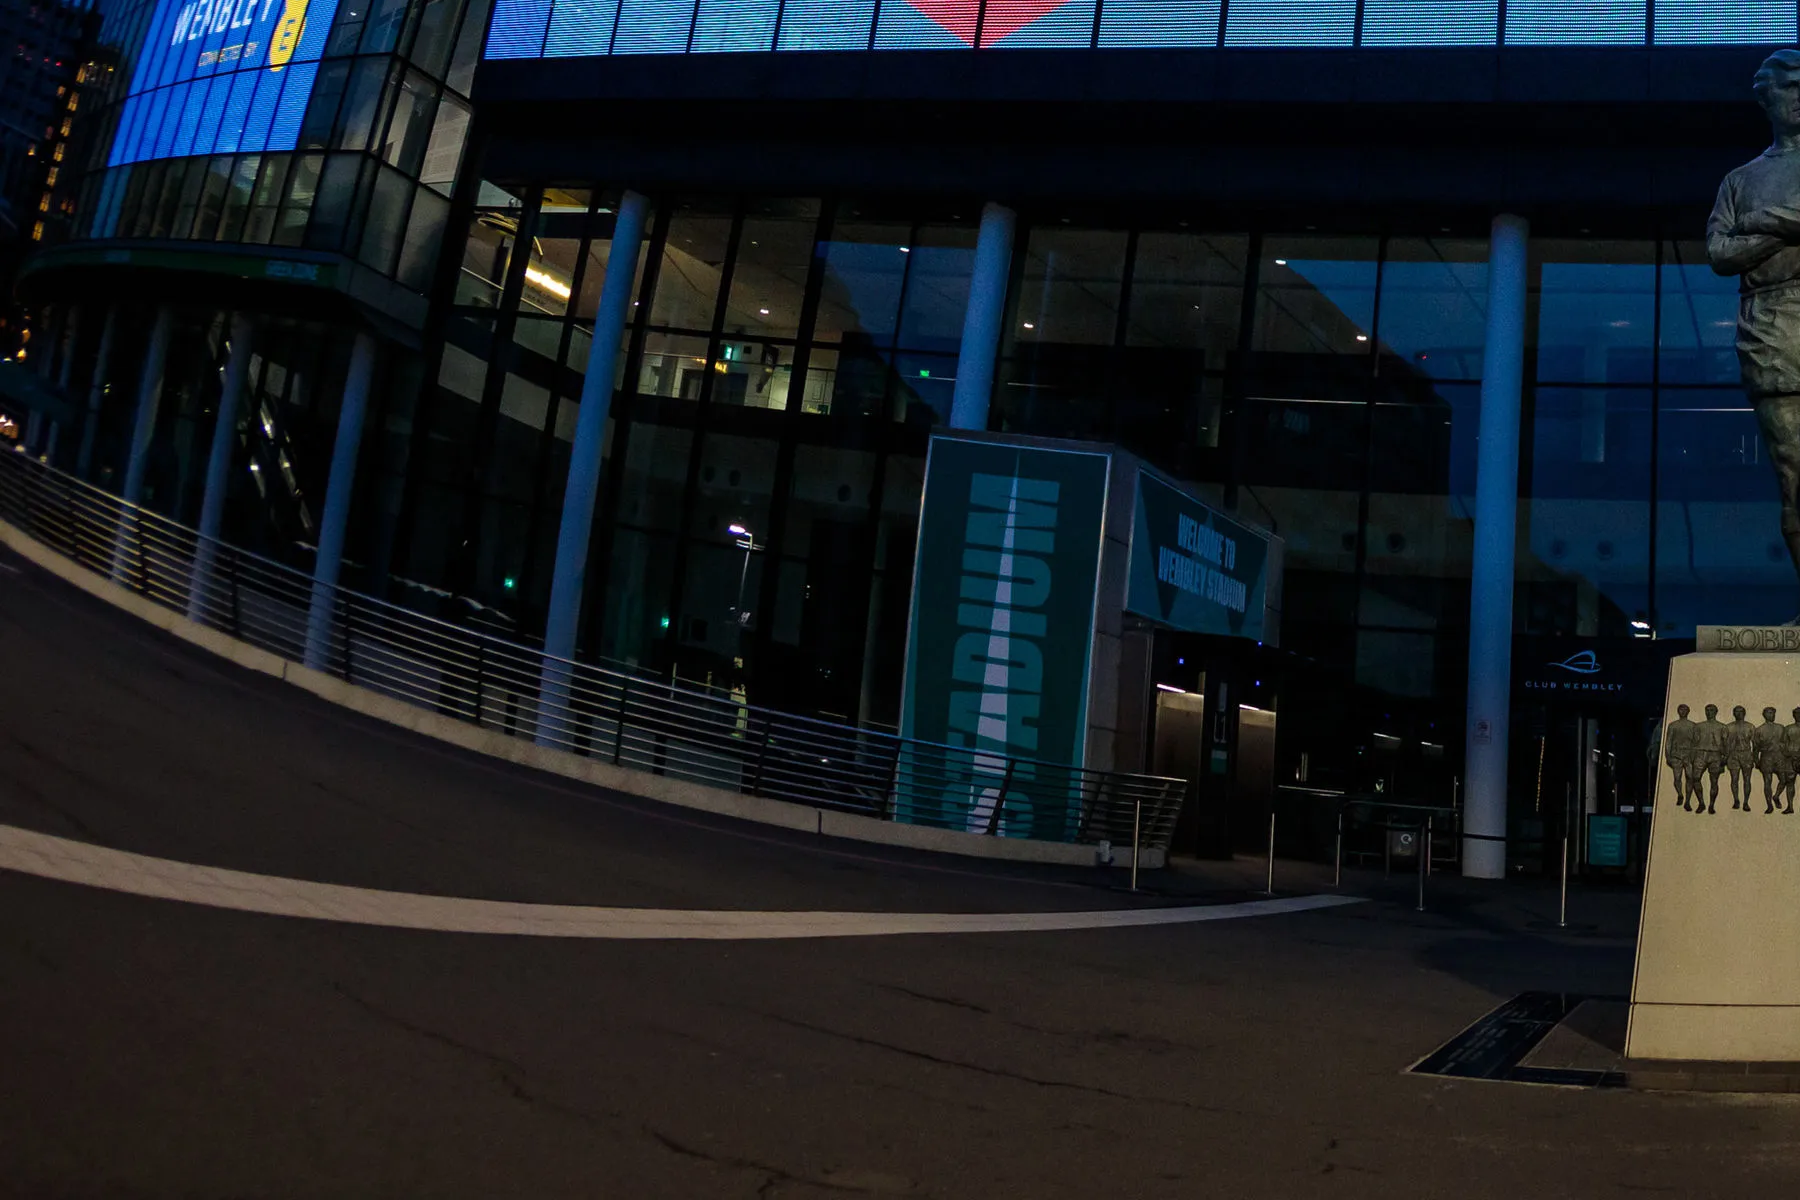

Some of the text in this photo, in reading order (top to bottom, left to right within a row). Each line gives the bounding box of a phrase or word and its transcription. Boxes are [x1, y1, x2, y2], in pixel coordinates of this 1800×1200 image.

[1178, 511, 1236, 571] WELCOME TO
[1158, 546, 1247, 613] WEMBLEY STADIUM
[940, 472, 1060, 838] STADIUM
[1524, 680, 1623, 691] CLUB WEMBLEY
